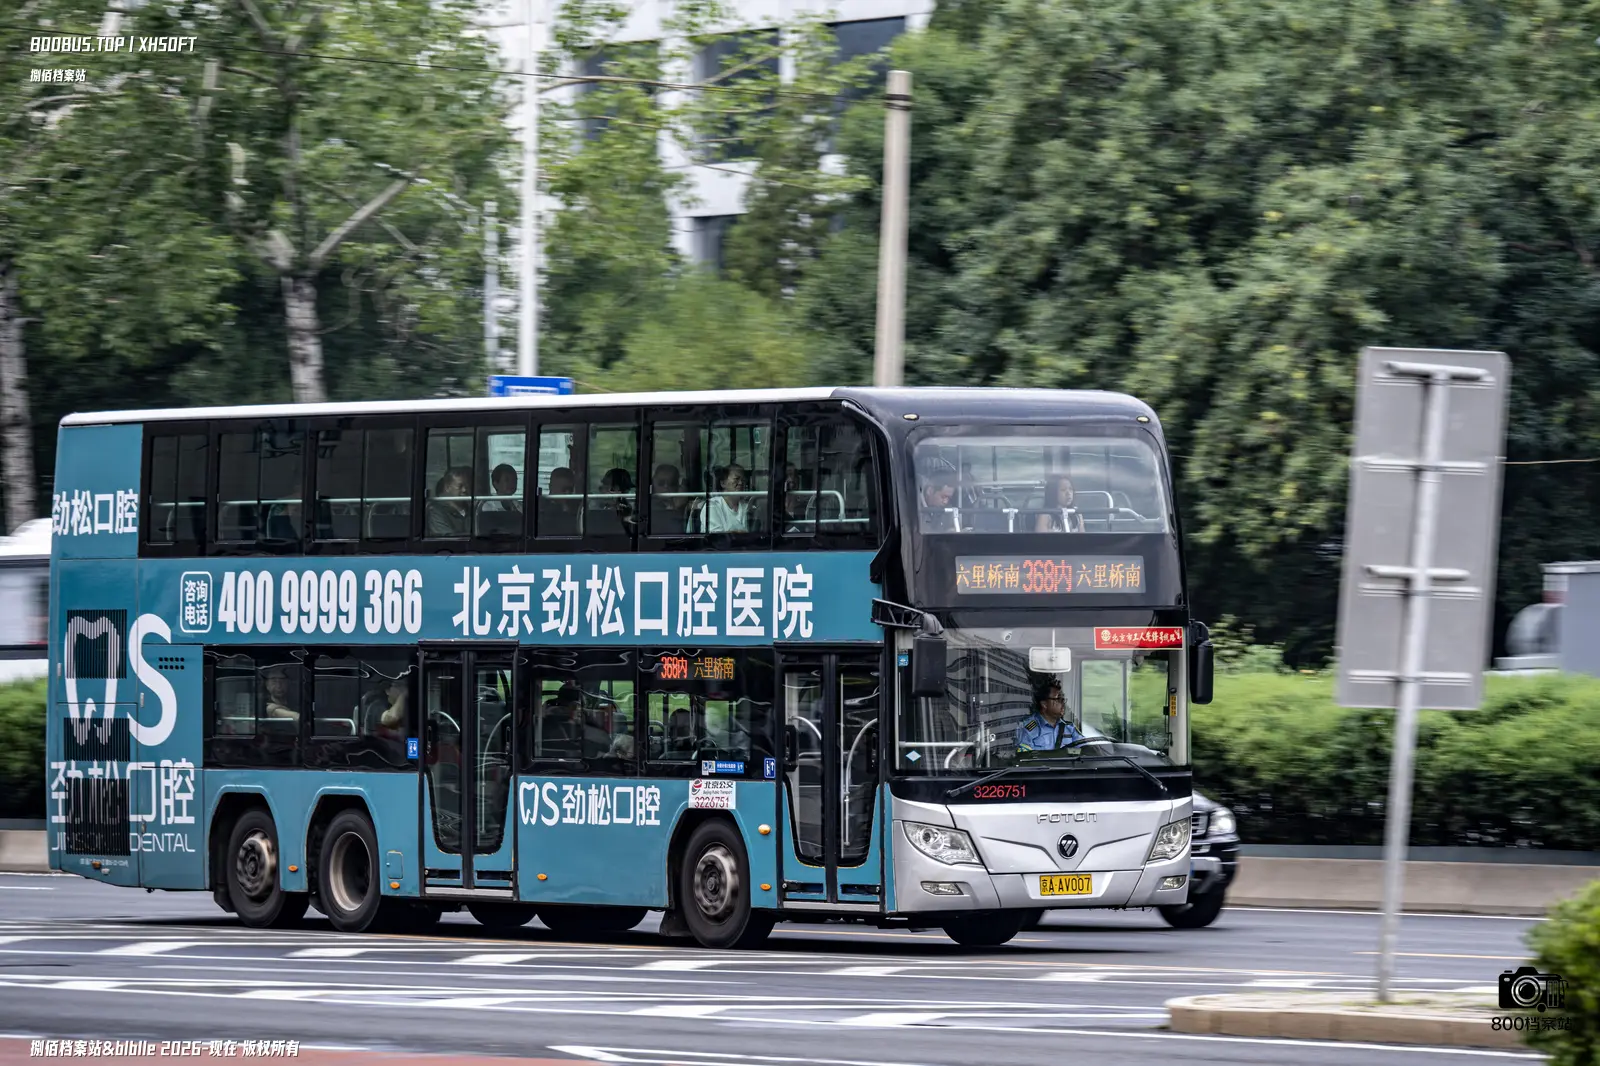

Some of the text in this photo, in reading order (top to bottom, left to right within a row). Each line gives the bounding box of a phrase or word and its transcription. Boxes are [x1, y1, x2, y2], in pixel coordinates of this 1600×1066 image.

[52, 489, 139, 536] 劲松口腔
[956, 559, 1141, 593] 六里桥南 368内 六里桥南
[184, 580, 208, 602] 咨询
[218, 569, 423, 634] 400 9999 366
[452, 564, 813, 638] 北京劲松口腔医院
[184, 604, 208, 626] 电话
[661, 656, 735, 679] 368内 六里桥南
[704, 780, 734, 789] 北京公交
[973, 785, 1027, 798] 3226751
[561, 783, 661, 826] 劲松口腔
[694, 796, 729, 808] 3226751
[129, 833, 196, 853] DENTAL
